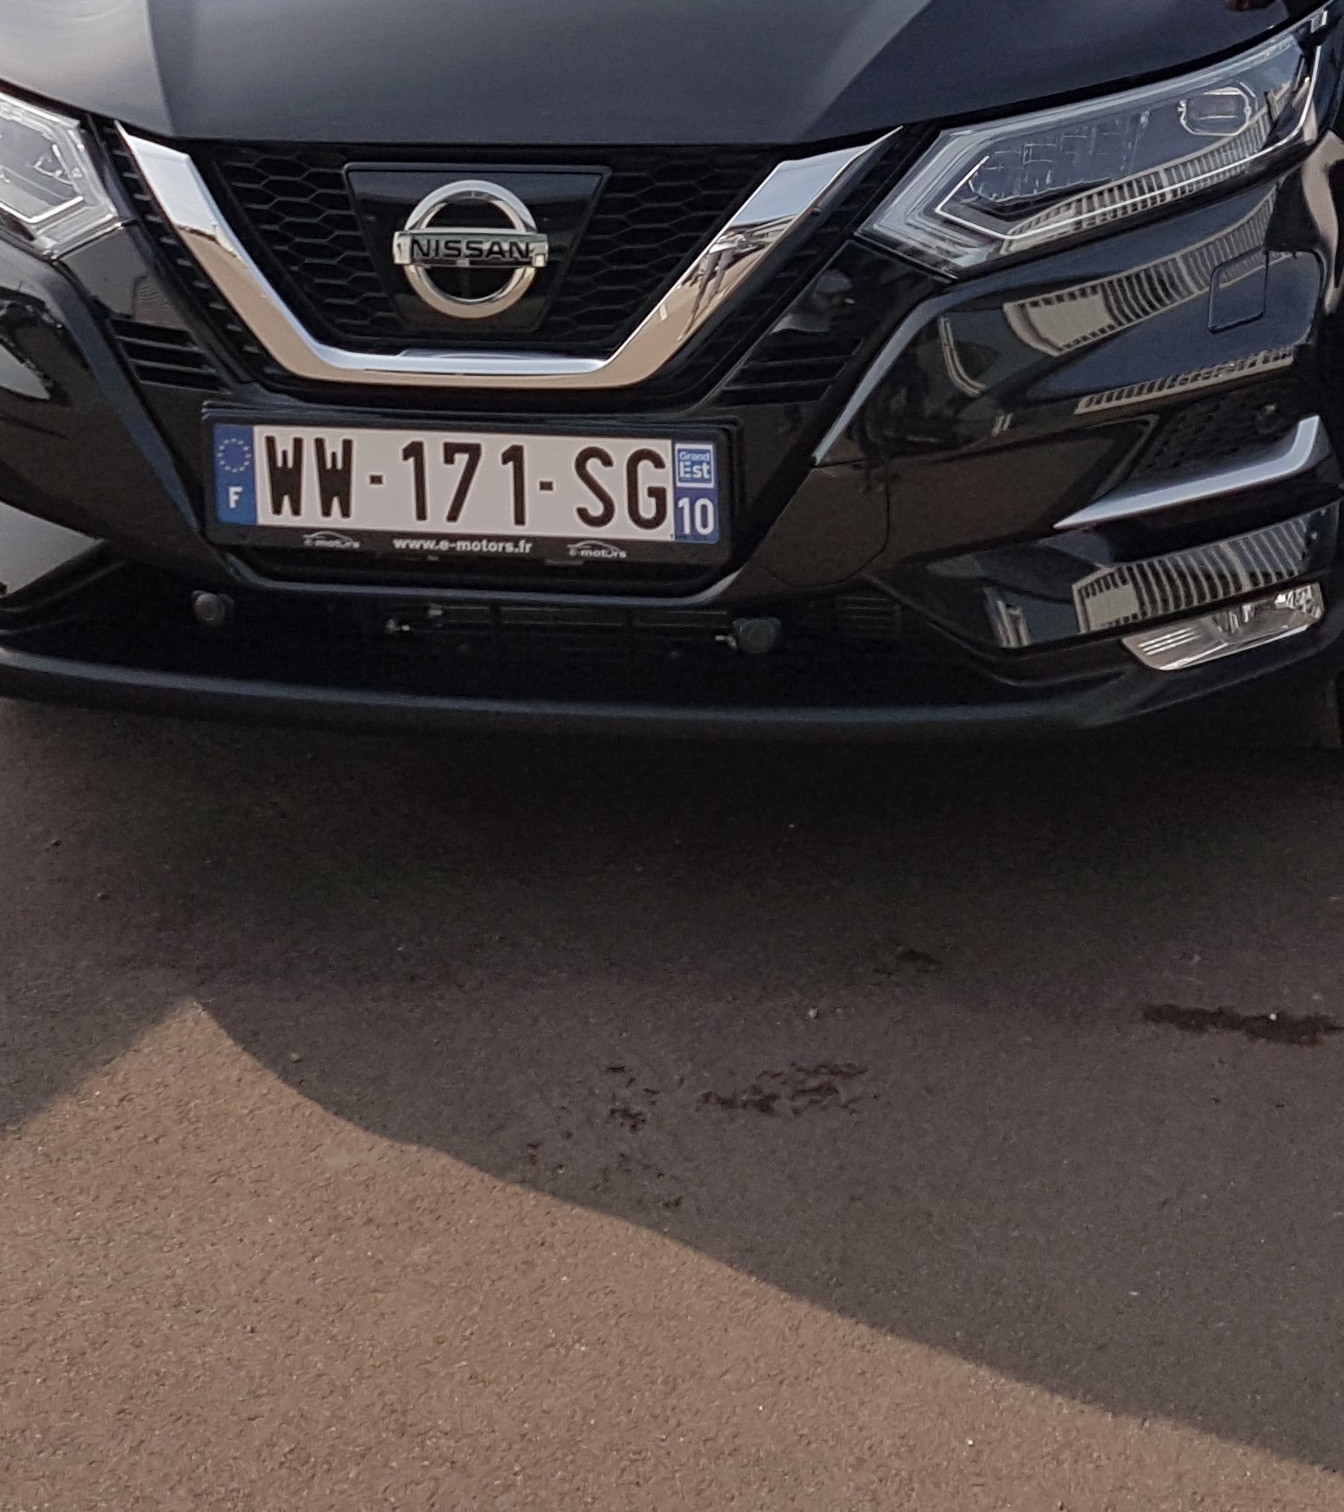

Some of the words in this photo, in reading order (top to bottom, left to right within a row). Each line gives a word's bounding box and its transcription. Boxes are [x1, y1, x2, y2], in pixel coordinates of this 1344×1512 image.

[410, 238, 531, 260] NISSAN
[678, 451, 710, 461] Grand
[679, 461, 711, 479] Est
[228, 486, 243, 508] F
[677, 496, 714, 535] 10
[393, 538, 532, 553] www.e-motors.fr
